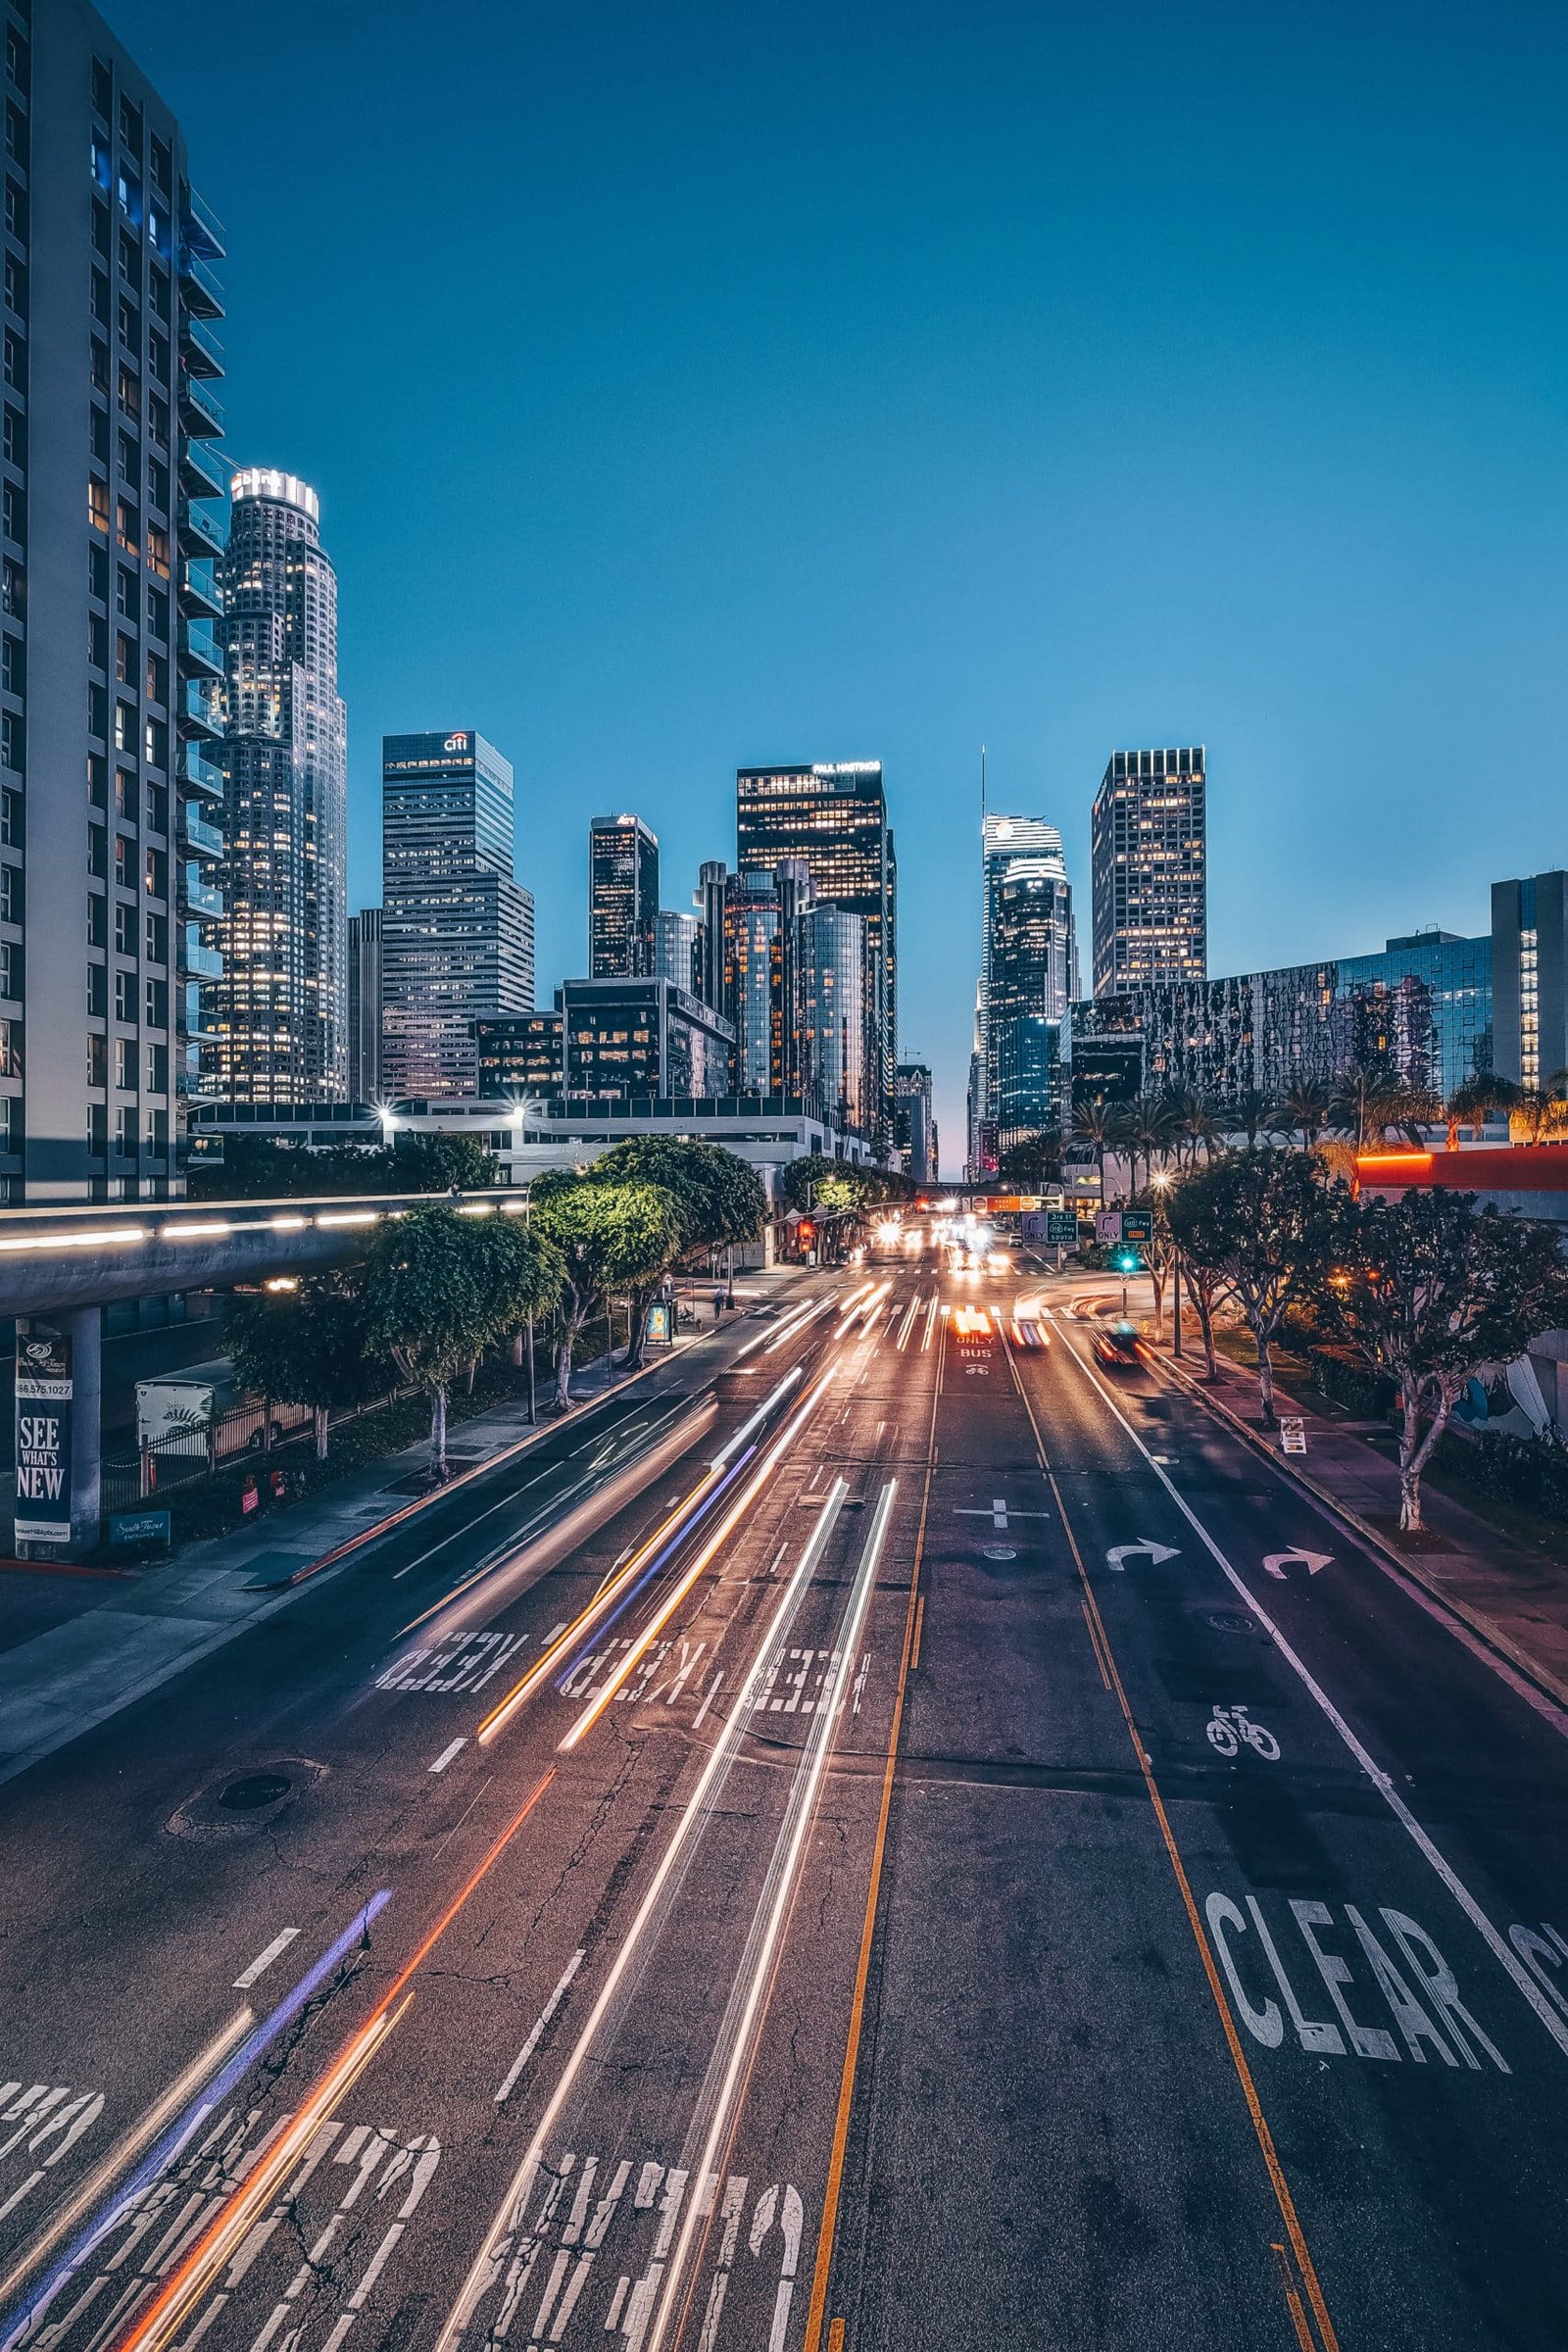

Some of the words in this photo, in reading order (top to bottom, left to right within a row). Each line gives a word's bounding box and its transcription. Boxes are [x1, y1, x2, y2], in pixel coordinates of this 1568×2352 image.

[444, 734, 467, 752] citi
[960, 1348, 992, 1358] BUS
[17, 1383, 71, 1396] 66.575.1027
[20, 1417, 59, 1450] SEE
[22, 1450, 57, 1466] WHAT'S
[17, 1466, 65, 1500] NEW
[1205, 1891, 1513, 2075] CLEAR
